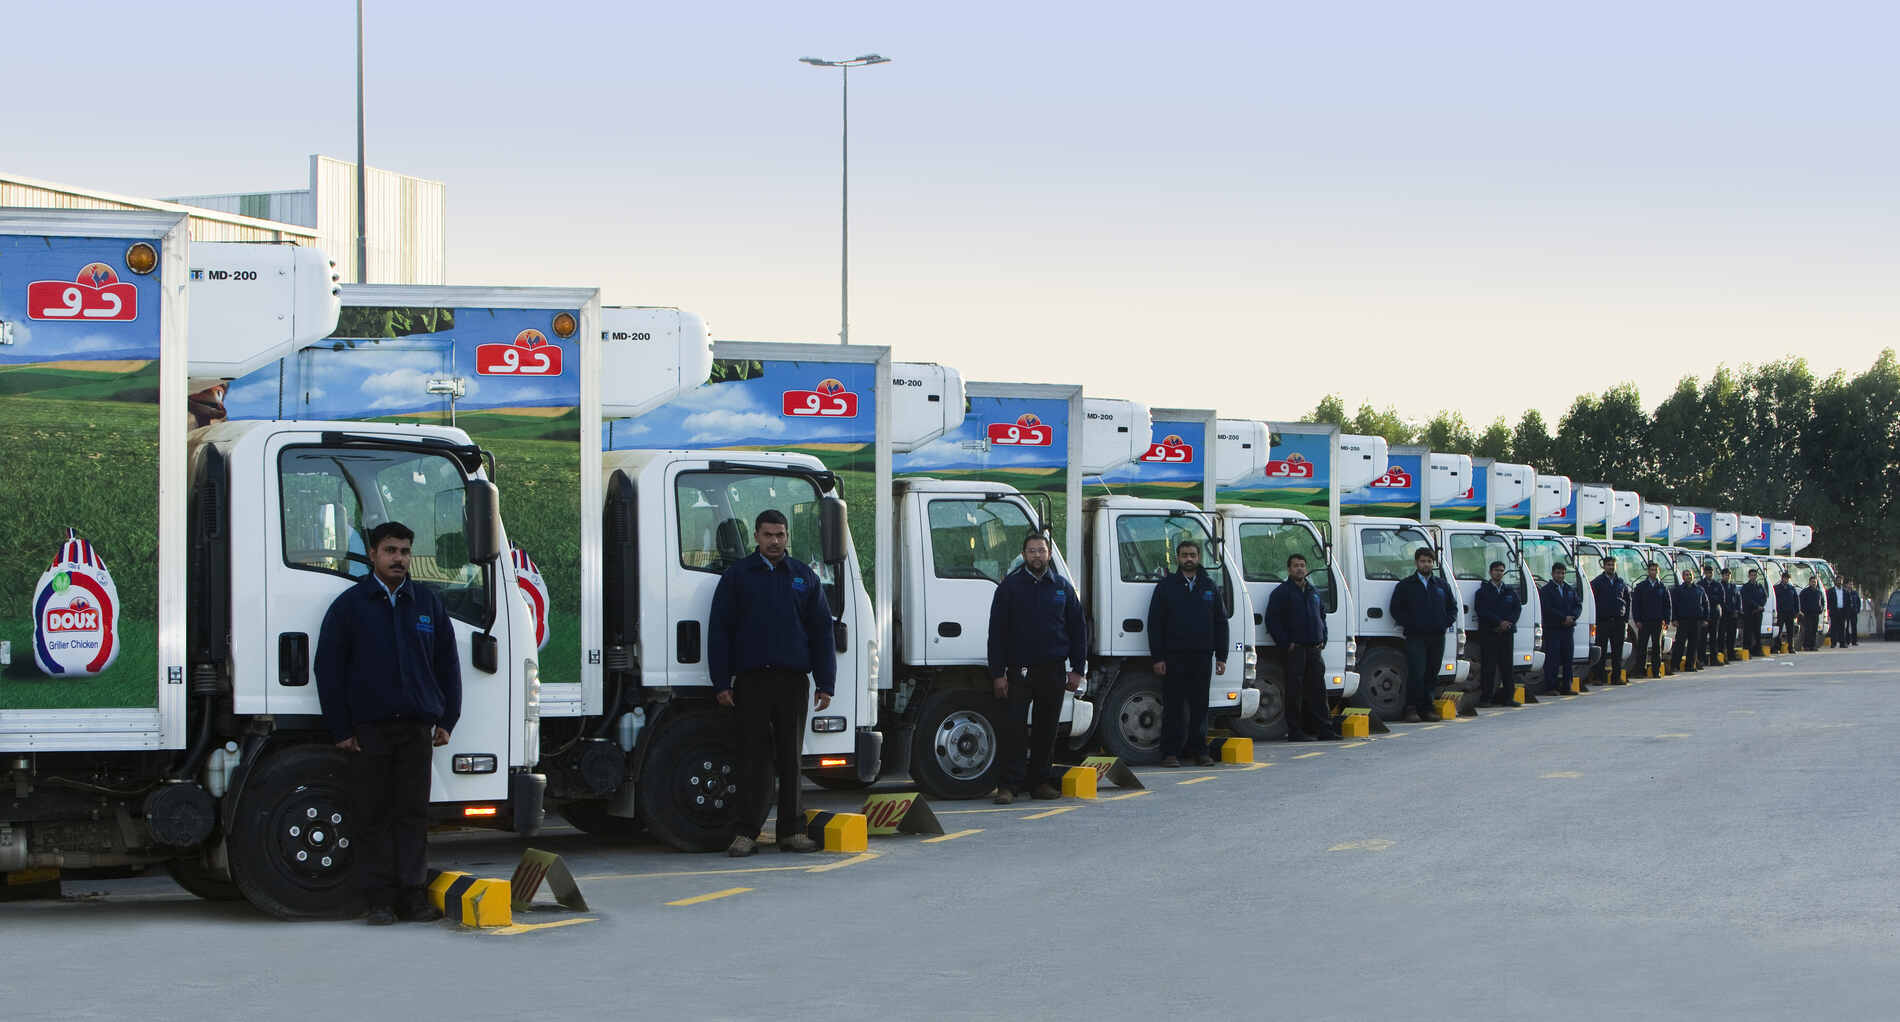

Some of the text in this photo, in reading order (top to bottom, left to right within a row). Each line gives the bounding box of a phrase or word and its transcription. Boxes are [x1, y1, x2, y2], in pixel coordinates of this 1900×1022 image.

[208, 270, 258, 281] MD-200
[612, 332, 651, 342] MD-200
[892, 378, 922, 388] MD-200
[1086, 412, 1114, 421] MD-200
[50, 612, 97, 630] DOUX
[49, 640, 99, 650] Griller Chicken
